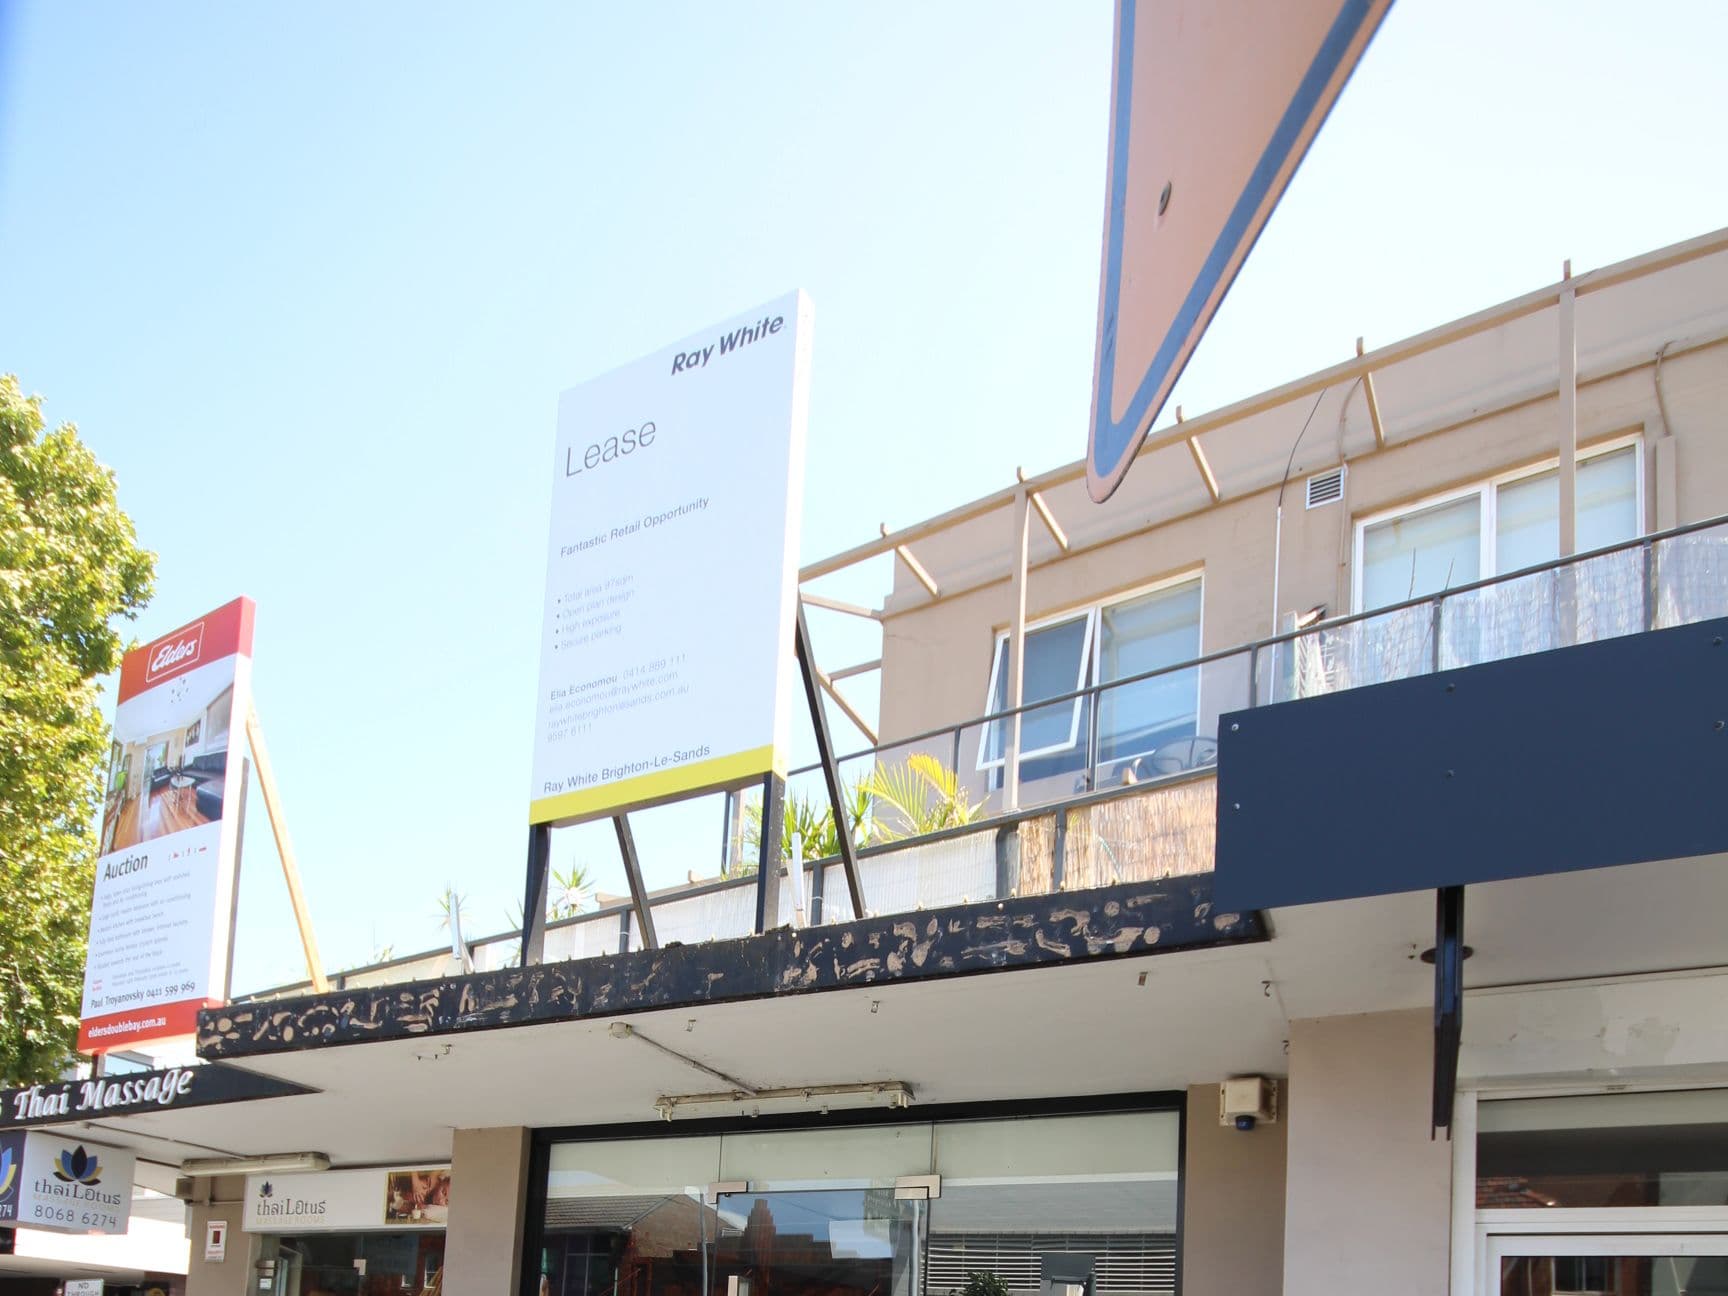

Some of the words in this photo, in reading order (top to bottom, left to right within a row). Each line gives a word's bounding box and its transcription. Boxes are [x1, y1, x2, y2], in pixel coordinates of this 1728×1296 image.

[671, 344, 715, 375] Ray
[719, 315, 784, 356] White
[565, 420, 657, 478] Lease
[560, 532, 607, 558] Fantastic
[610, 521, 641, 540] Retail
[643, 496, 710, 529] Opportunity
[150, 639, 198, 673] Elders
[543, 781, 564, 794] Ray
[567, 770, 598, 788] White
[601, 744, 711, 782] Brighton-Le-Sands
[103, 853, 149, 882] Auction
[14, 1083, 71, 1120] Thai
[76, 1067, 194, 1111] Massage
[34, 1204, 75, 1223] 8068
[81, 1208, 118, 1228] 6274
[78, 1282, 89, 1290] NO
